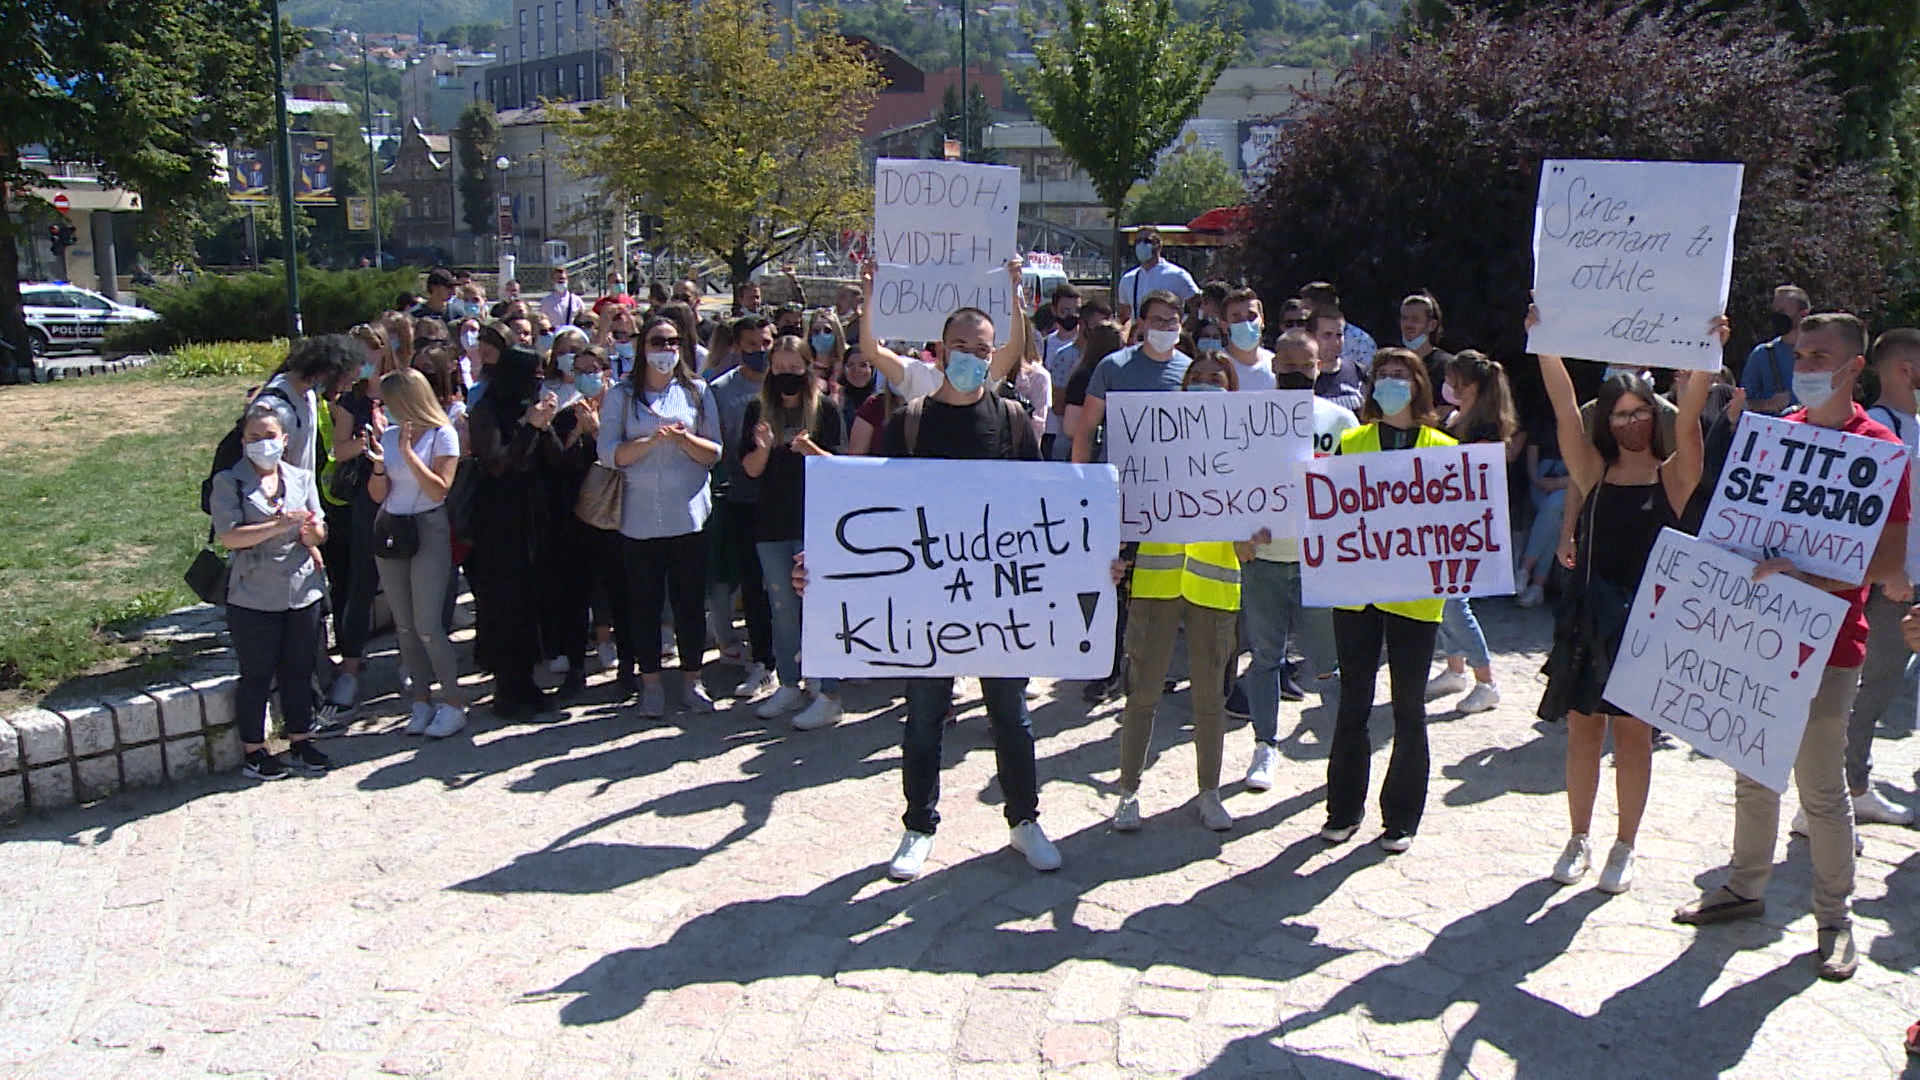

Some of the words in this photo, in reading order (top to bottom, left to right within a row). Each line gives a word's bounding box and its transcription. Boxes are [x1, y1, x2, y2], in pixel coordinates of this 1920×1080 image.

[881, 169, 1008, 213] DOĐOH,
[1567, 226, 1672, 253] nemam
[1685, 225, 1713, 257] ti
[1571, 258, 1655, 292] otkle
[51, 325, 104, 336] POLICIJA
[1120, 404, 1210, 444] VIDIM
[1119, 455, 1170, 485] ALI
[1188, 451, 1235, 478] NE
[1305, 452, 1489, 520] Dobrodošli
[1740, 431, 1759, 462] I
[1779, 438, 1878, 488] TITO
[1121, 483, 1295, 535] LjUDSKOS
[1724, 467, 1775, 506] SE
[1781, 480, 1884, 527] BOJAO
[822, 497, 1091, 579] Studenti
[1303, 535, 1324, 568] u
[1336, 507, 1500, 562] stvarnost
[1708, 507, 1865, 570] STUDENATA
[944, 567, 974, 603] A
[994, 560, 1045, 598] NE
[1428, 559, 1481, 594] !!!
[1691, 560, 1832, 641] STUDIRAMO
[1676, 598, 1783, 660] SAMO
[1630, 629, 1650, 658] U
[1664, 640, 1779, 719] VRIJEME
[1650, 678, 1766, 766] IZBORA
